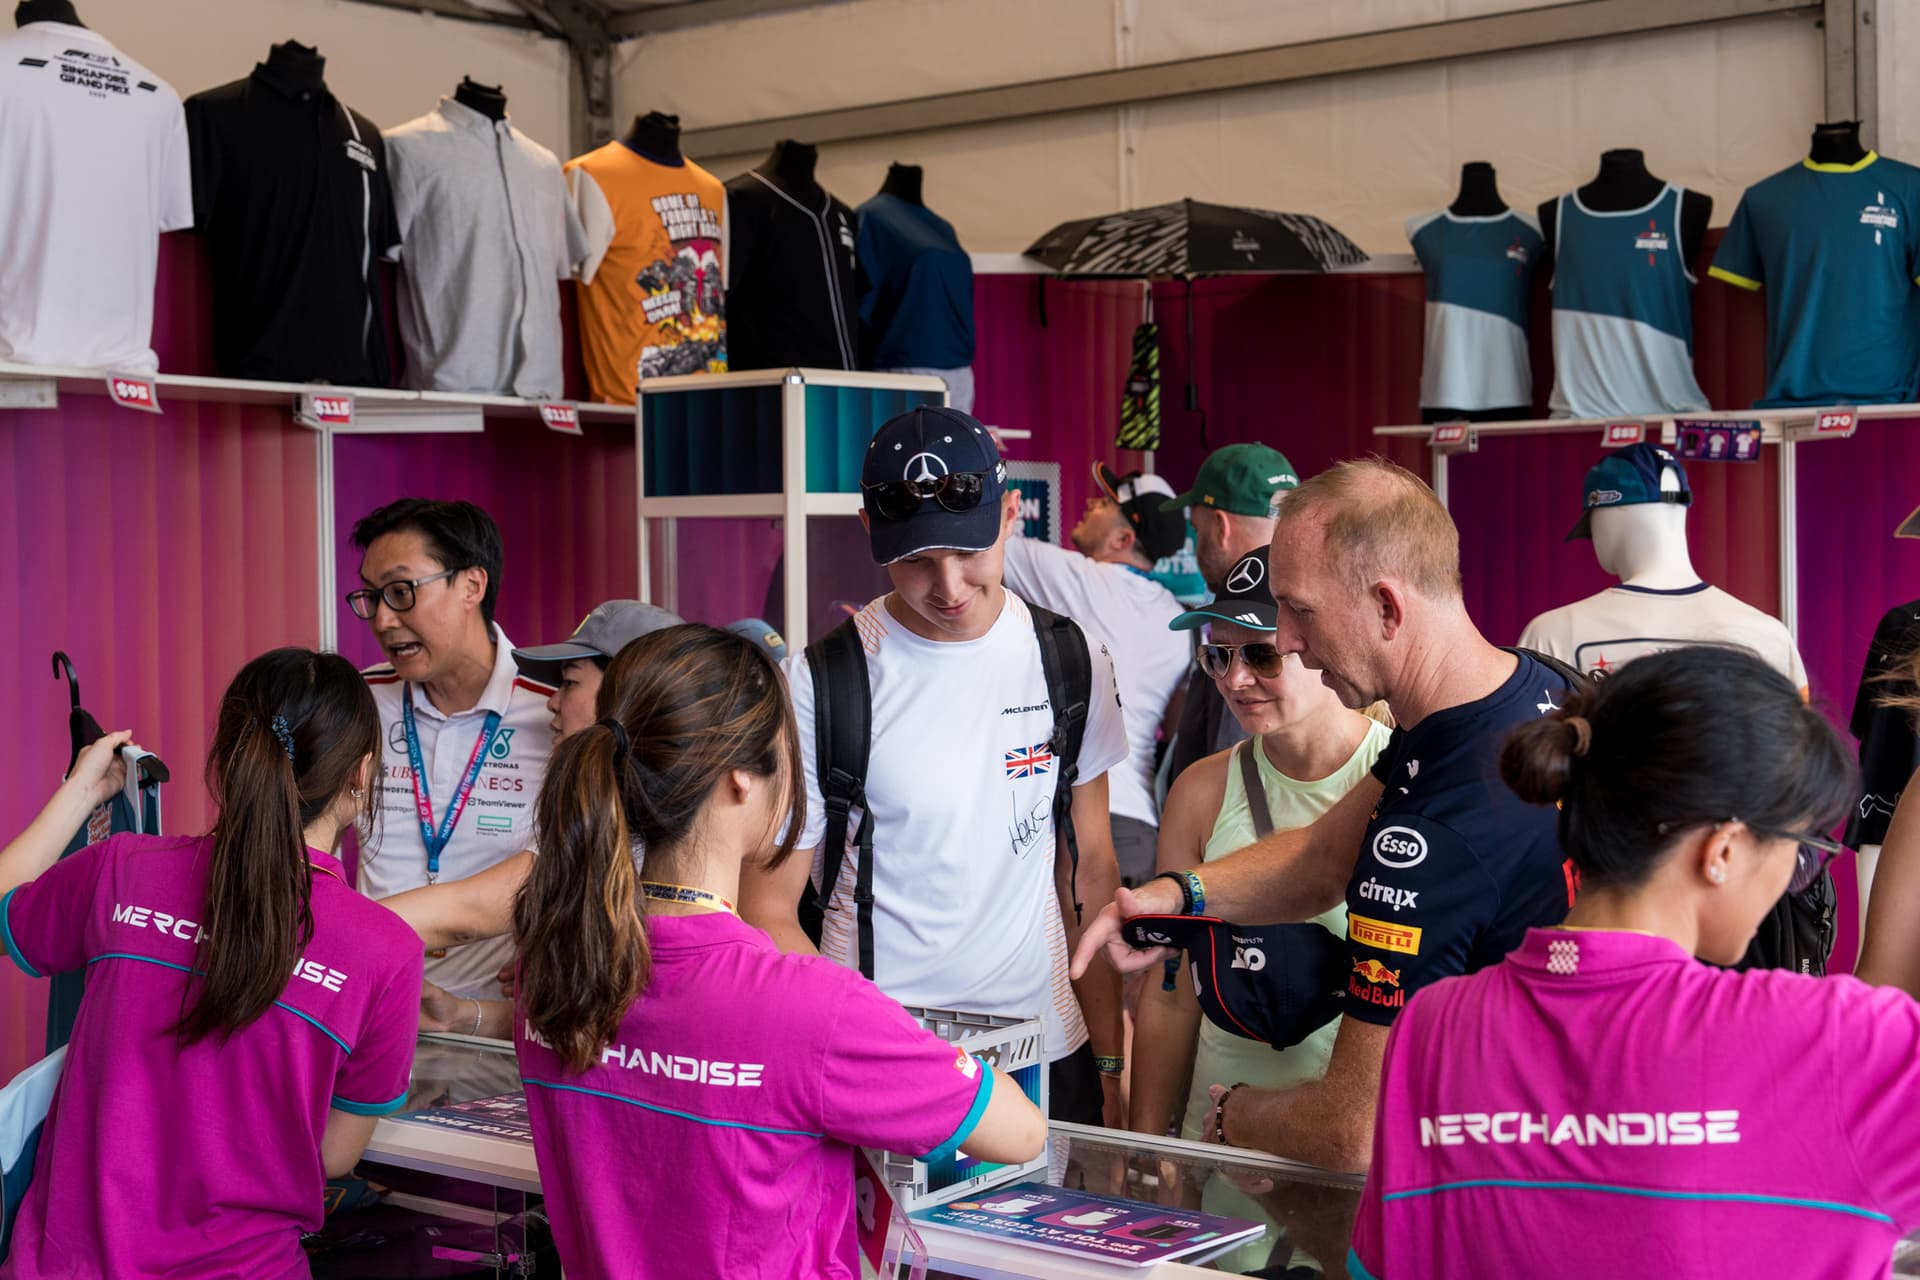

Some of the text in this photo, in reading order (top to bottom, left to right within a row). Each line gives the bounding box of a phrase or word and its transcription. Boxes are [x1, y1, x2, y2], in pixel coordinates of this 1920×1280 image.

[60, 62, 127, 85] SINGAPORE
[59, 72, 131, 96] GRAND PRIX
[116, 382, 149, 400] $95
[1822, 415, 1851, 428] $70
[1001, 700, 1050, 715] McLaren
[477, 799, 527, 809] TeamViewer
[1352, 918, 1414, 949] PIRELLI
[1348, 974, 1405, 1008] Red Bull
[947, 1211, 989, 1221] OFF
[990, 1218, 1034, 1230] 50%
[1032, 1227, 1065, 1235] AT
[1064, 1233, 1107, 1244] TOP
